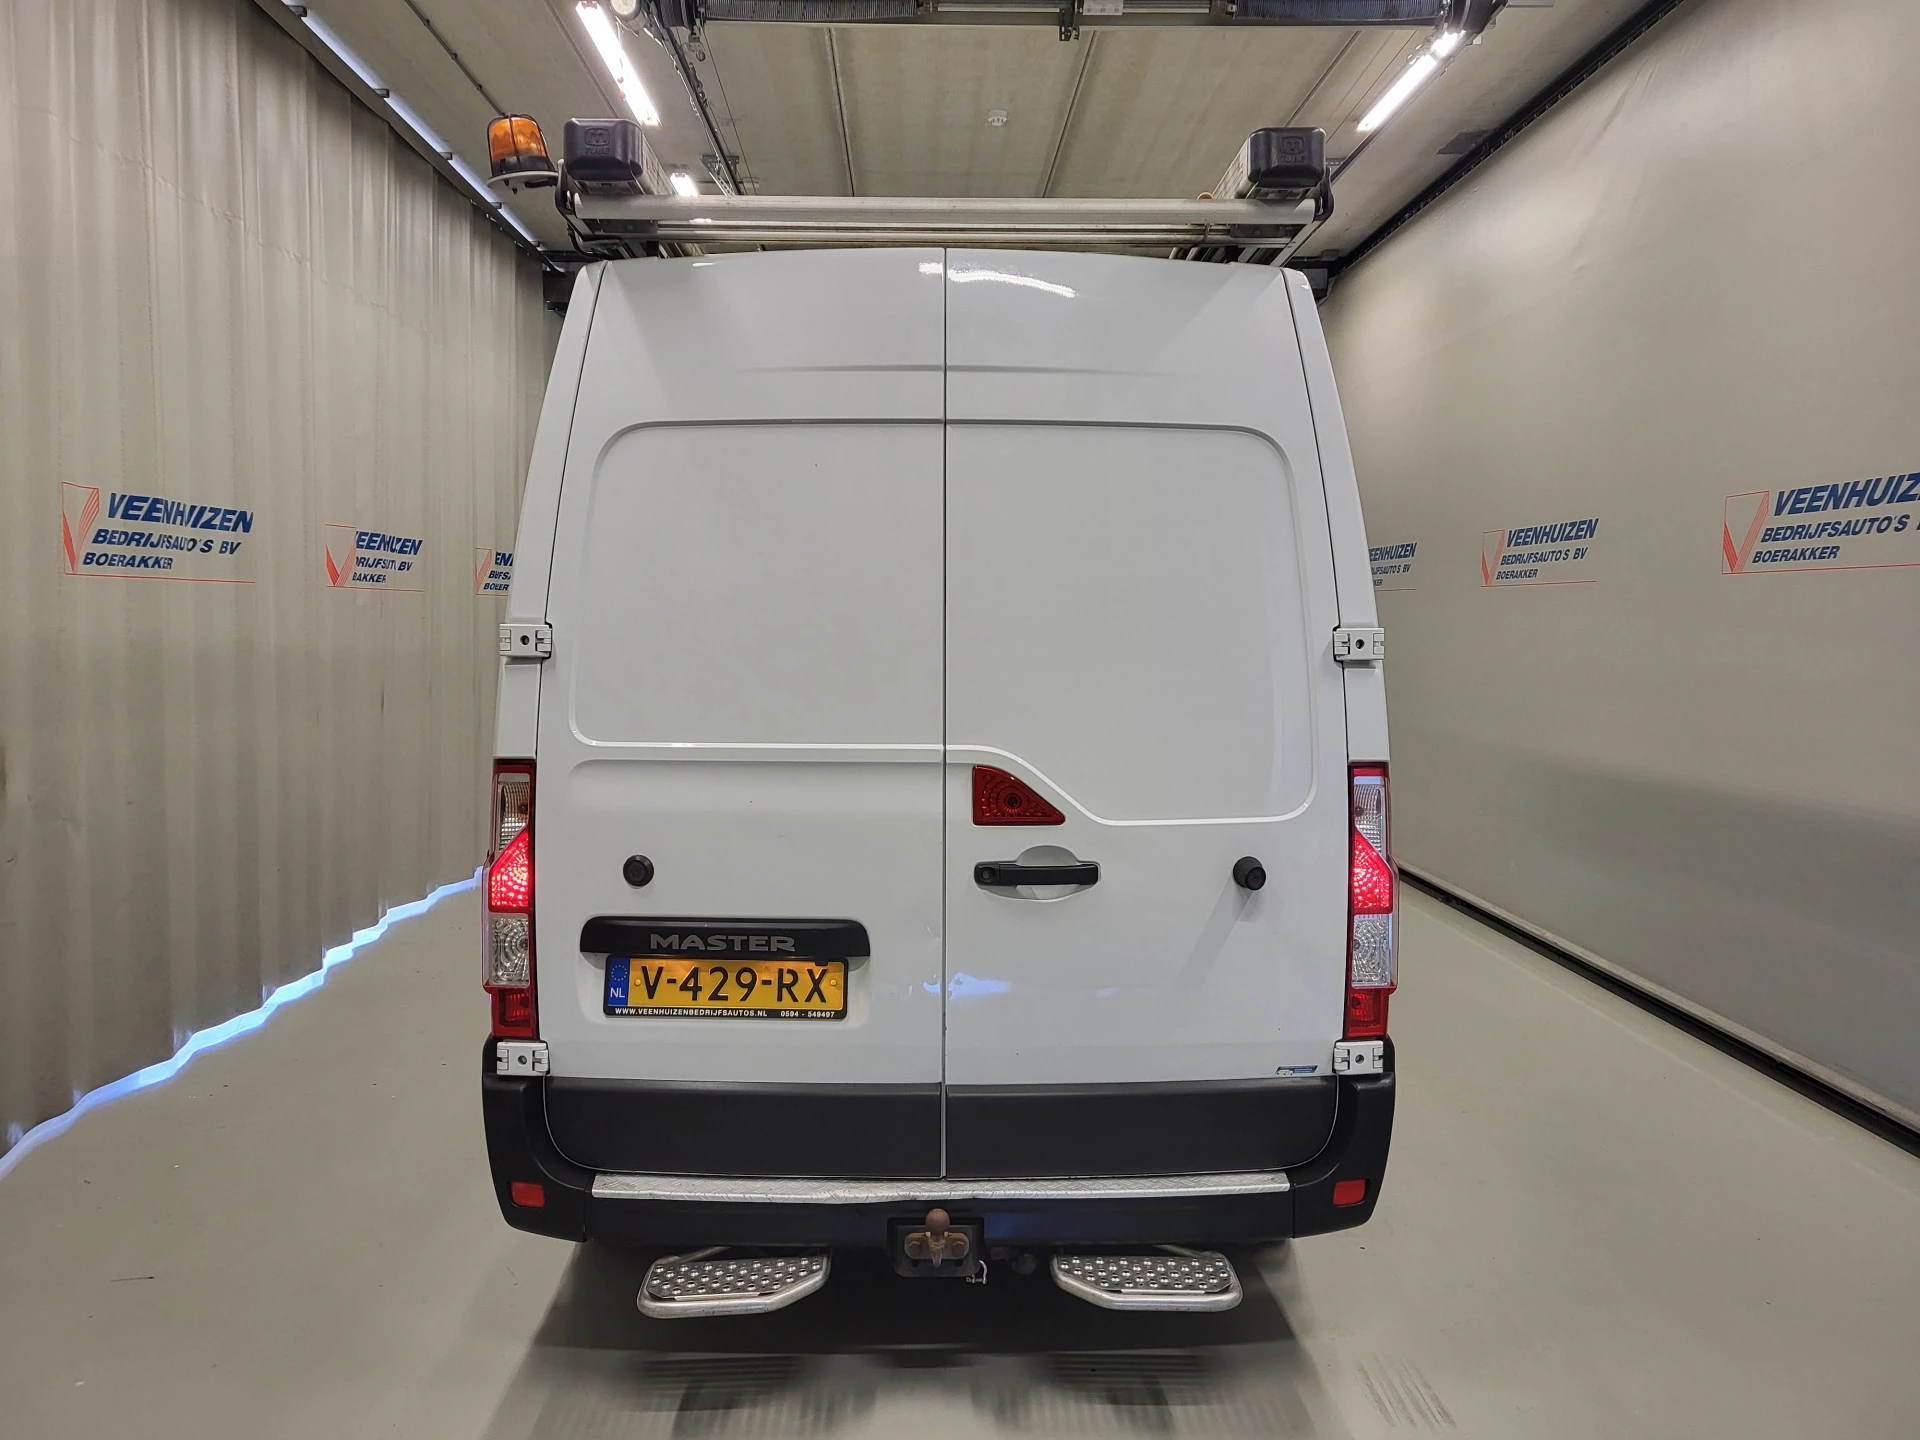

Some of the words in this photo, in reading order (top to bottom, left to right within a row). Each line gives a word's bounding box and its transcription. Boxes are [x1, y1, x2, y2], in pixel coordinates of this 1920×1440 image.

[1773, 472, 1920, 517] VEENHUIZ
[107, 492, 254, 533] VEENHUIZEN
[1506, 518, 1600, 548] VEENHUIZEN
[1760, 514, 1911, 543] BEDRIJFSAUTO'S
[91, 528, 215, 554] BEDRIJFSAUO'S
[218, 540, 242, 555] BV
[82, 551, 174, 570] BOERAKKER
[1500, 548, 1571, 566] BEDRIJFSAUTO'S
[1572, 547, 1588, 560] BV
[1752, 545, 1841, 564] BOERAKKER
[397, 561, 414, 572] BV
[1402, 563, 1412, 573] BV
[1496, 568, 1539, 580] BOERAKKER
[650, 934, 796, 952] MASTER
[610, 987, 626, 999] NL
[640, 965, 828, 1003] V-429-RX
[614, 1007, 768, 1018] WWW.VEENHUIZENBEDRIJFSAUTOS.NL
[780, 1010, 799, 1018] 0594
[807, 1011, 835, 1019] 549497
